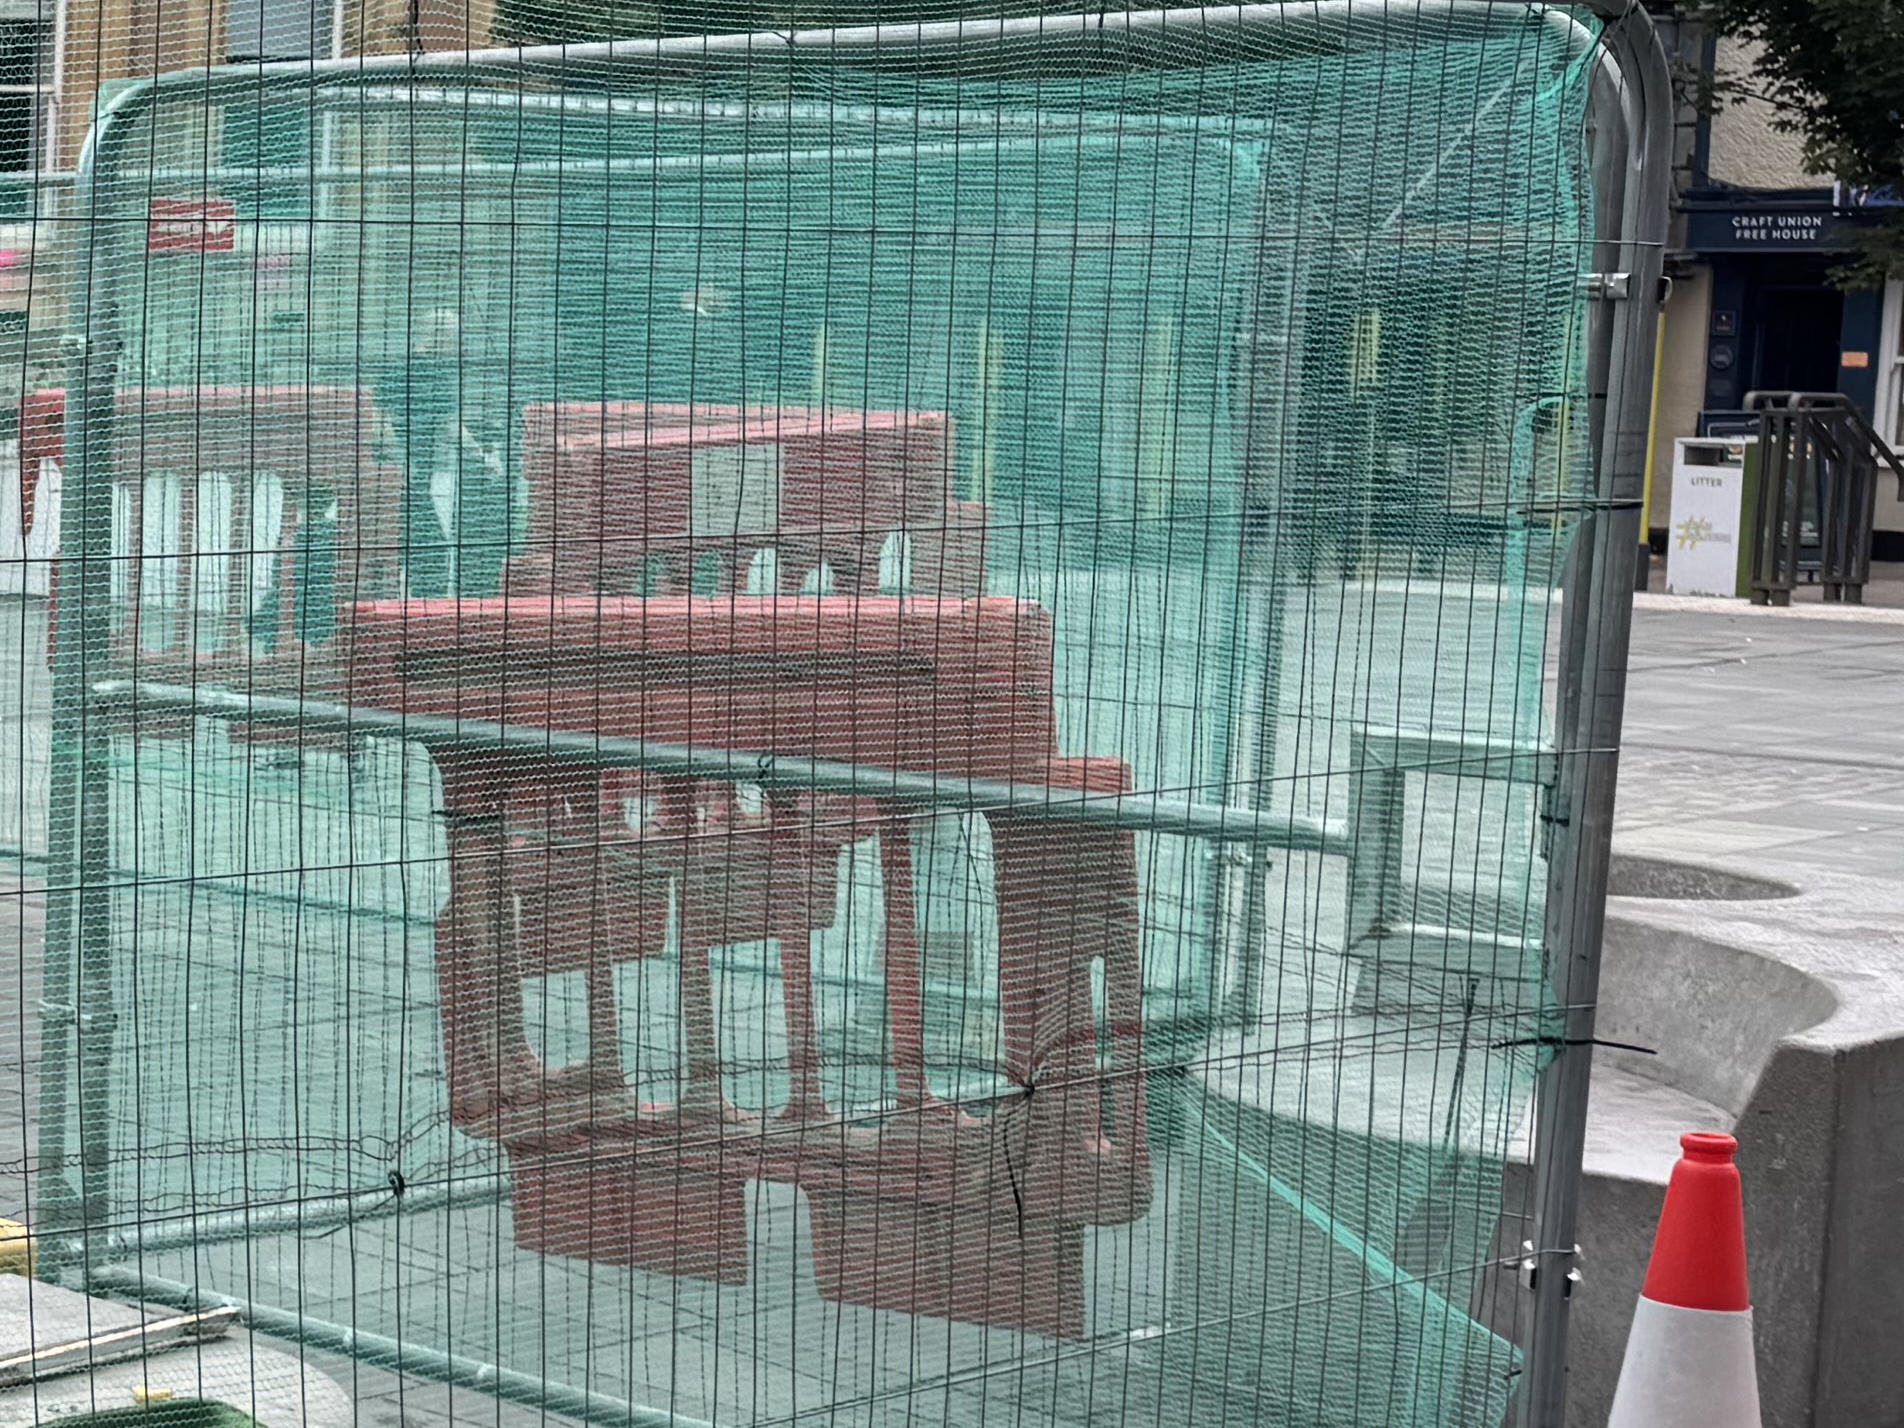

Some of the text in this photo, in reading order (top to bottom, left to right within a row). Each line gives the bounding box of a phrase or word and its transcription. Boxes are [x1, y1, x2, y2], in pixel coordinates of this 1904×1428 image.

[1732, 216, 1822, 227] CRAFT UNION
[1736, 229, 1817, 240] FREE HOUSE
[1690, 476, 1723, 487] LITTER
